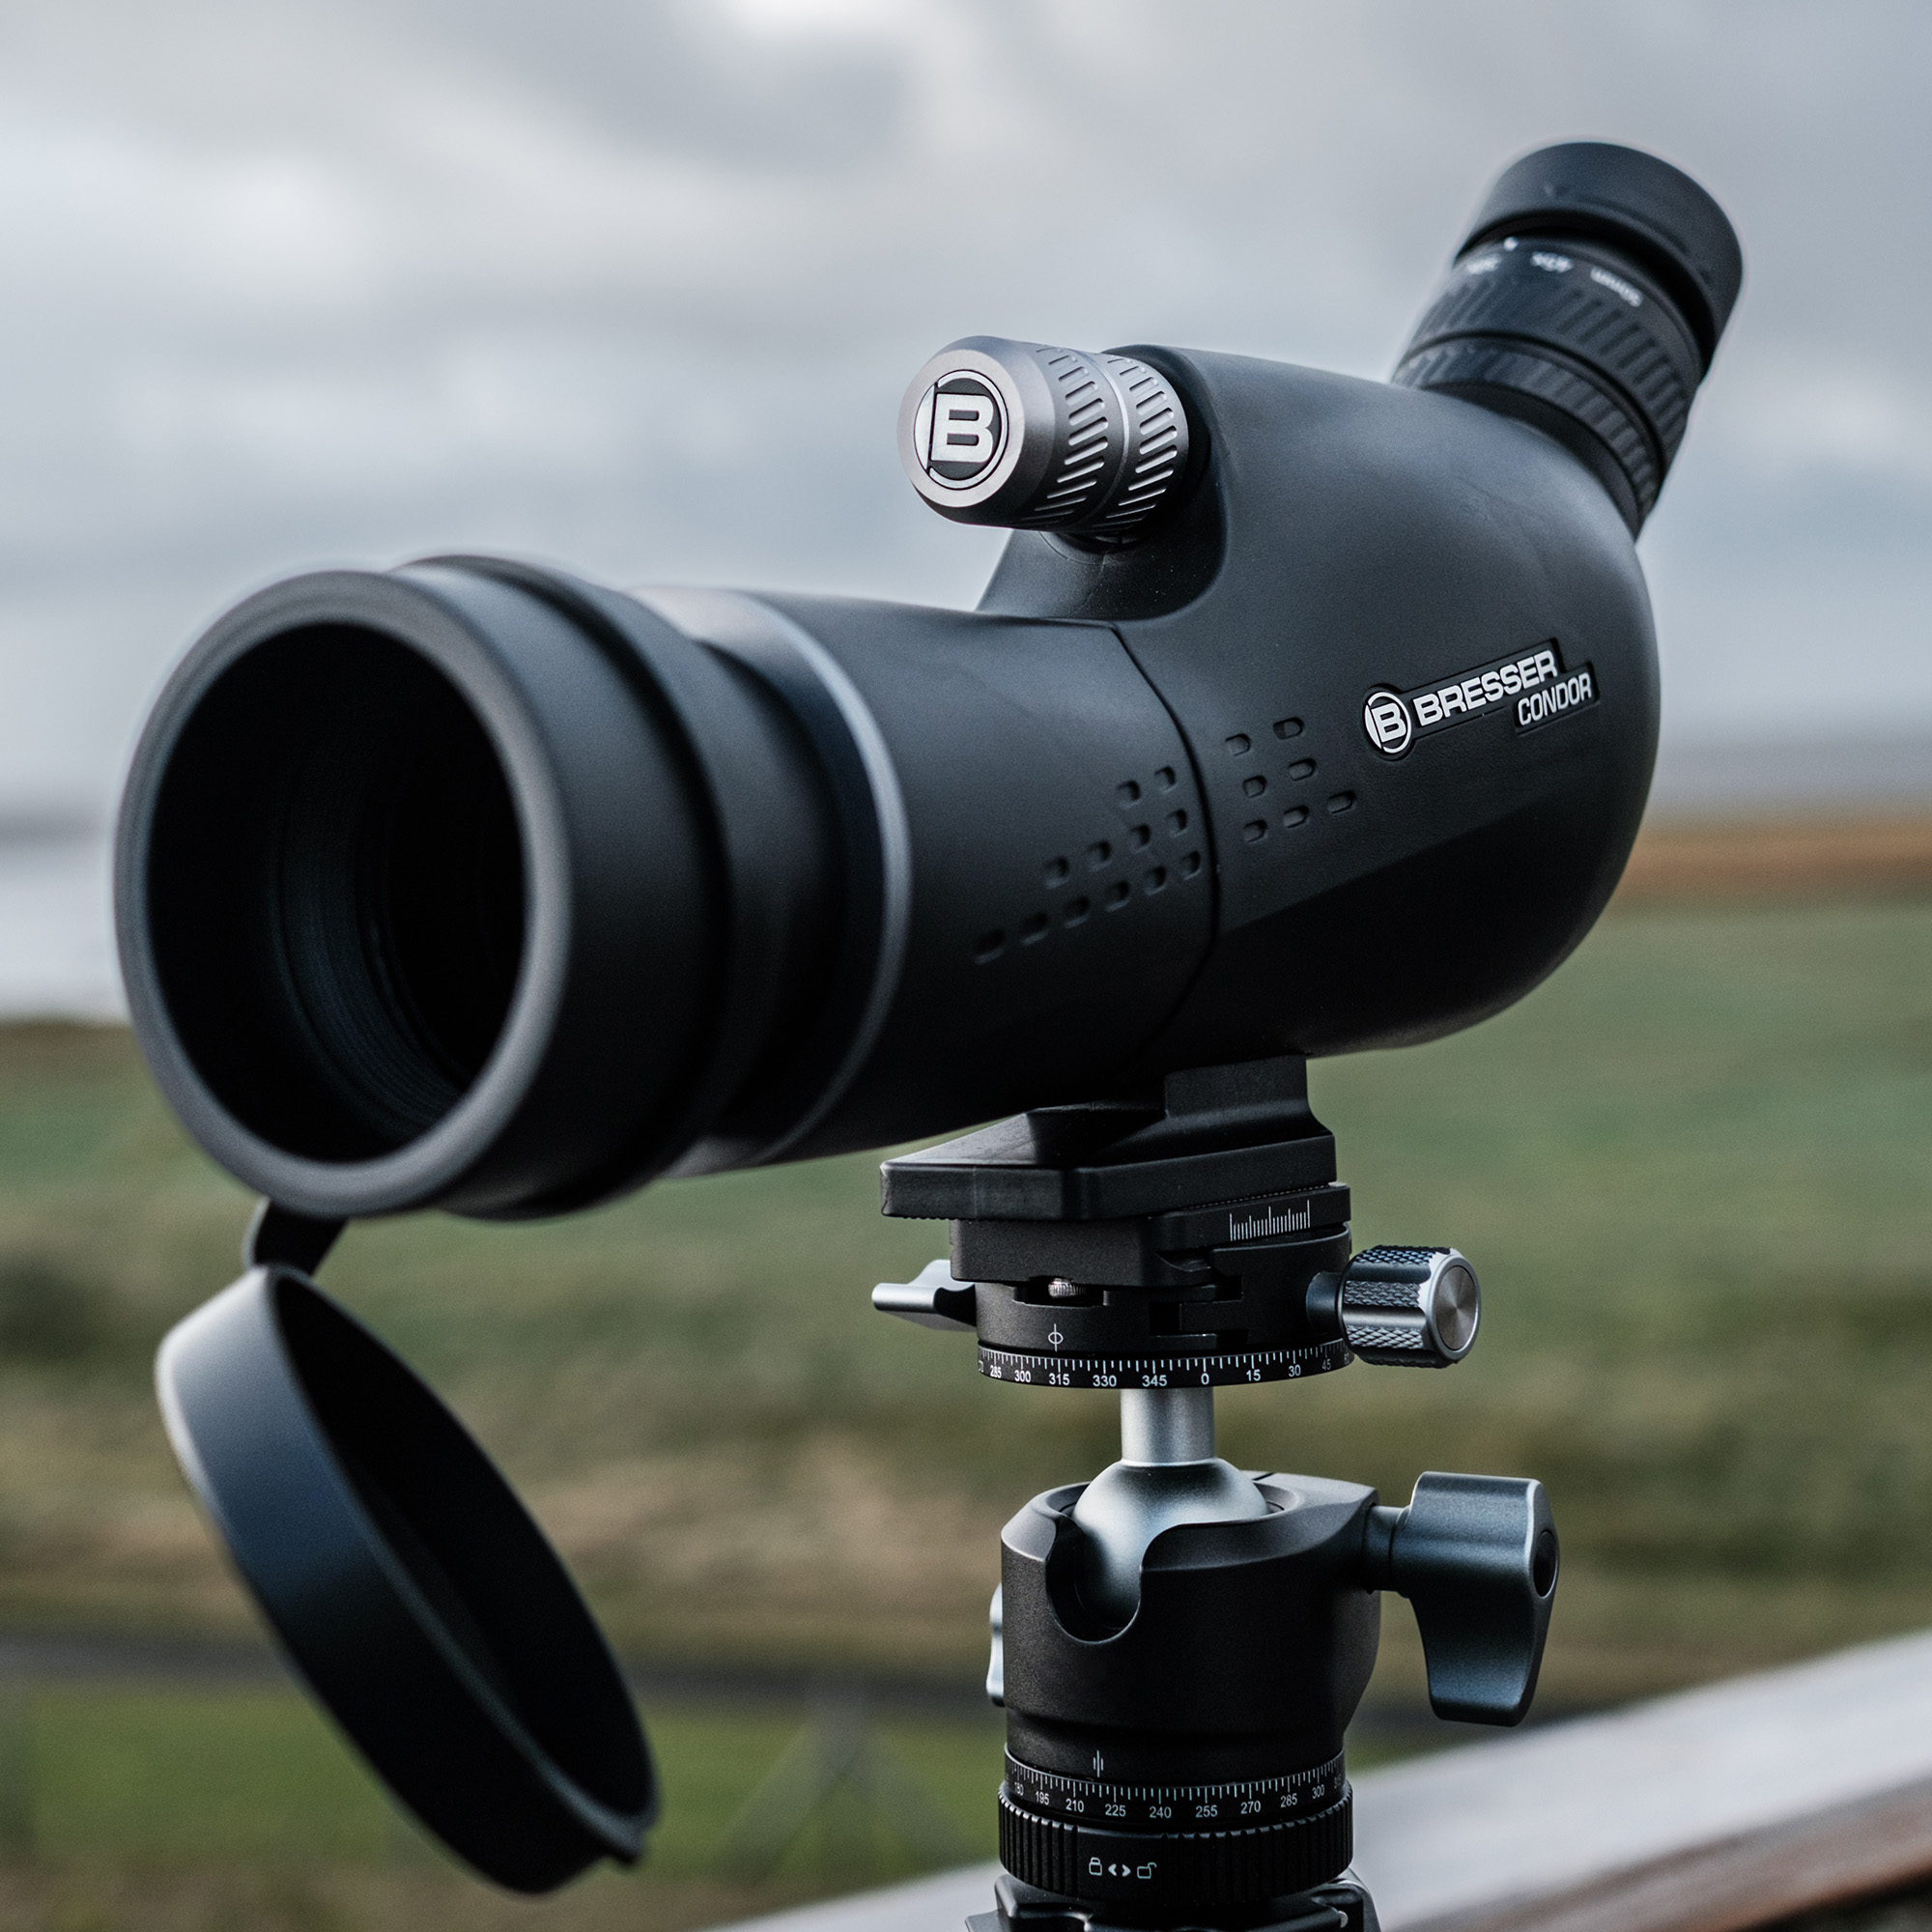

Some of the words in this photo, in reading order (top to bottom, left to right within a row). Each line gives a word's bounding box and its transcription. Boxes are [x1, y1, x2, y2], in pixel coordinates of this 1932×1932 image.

[930, 393, 994, 464] B
[1413, 649, 1558, 726] BRESSER
[1518, 672, 1593, 726] CONDOR
[1014, 1370, 1032, 1383] 300
[1049, 1373, 1070, 1386] 315
[1093, 1375, 1117, 1388] 330
[1142, 1375, 1168, 1388] 345
[1201, 1373, 1209, 1385] 0
[1246, 1369, 1262, 1381] 15
[1288, 1364, 1301, 1378] 30
[1321, 1358, 1332, 1371] 45
[1036, 1790, 1050, 1805] 195
[1065, 1798, 1085, 1813] 210
[1105, 1804, 1126, 1817] 225
[1149, 1805, 1172, 1819] 240
[1195, 1804, 1218, 1818] 255
[1240, 1800, 1262, 1814] 270
[1280, 1793, 1298, 1807] 285
[1312, 1783, 1325, 1800] 300
